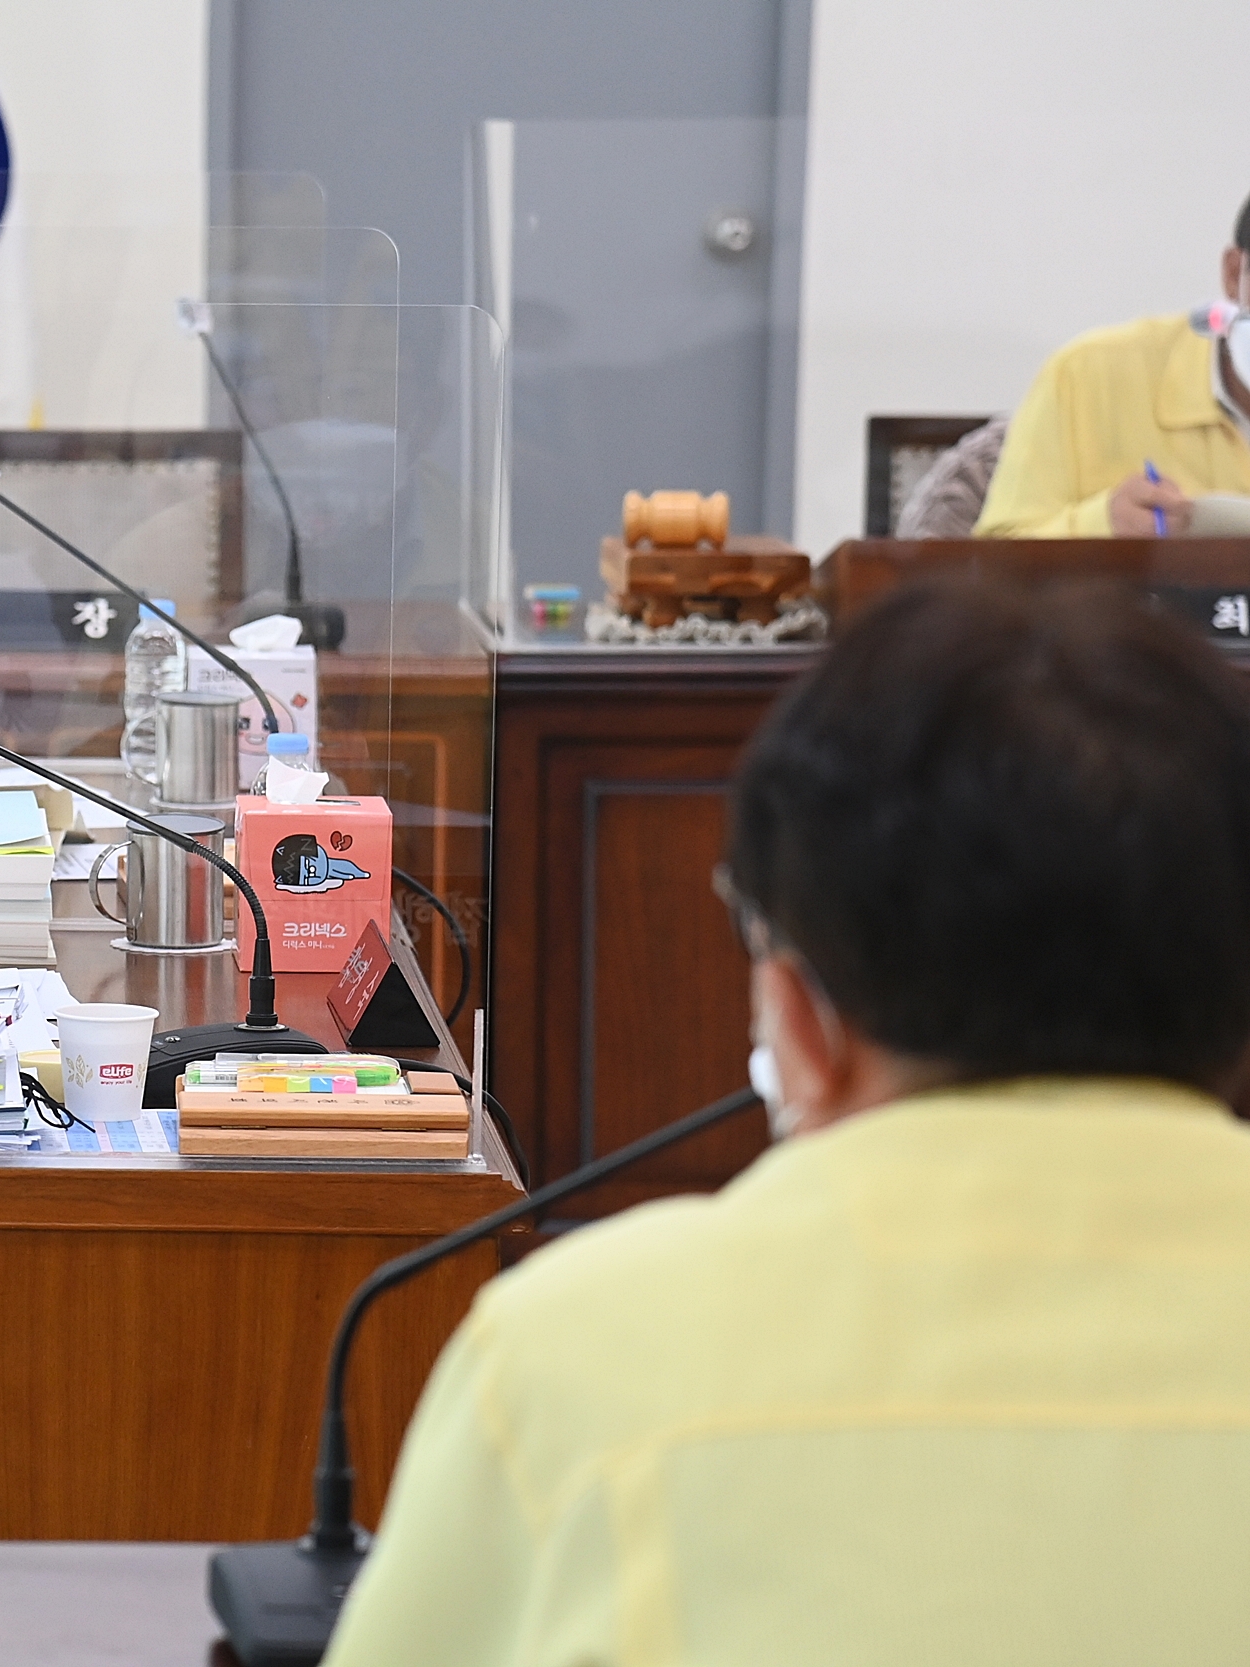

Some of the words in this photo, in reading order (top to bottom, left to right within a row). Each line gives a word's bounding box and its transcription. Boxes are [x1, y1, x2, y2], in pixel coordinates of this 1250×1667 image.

[71, 598, 118, 639] 장
[282, 922, 347, 938] 크리넥스
[282, 940, 306, 950] 디럭스
[307, 940, 322, 949] 미니
